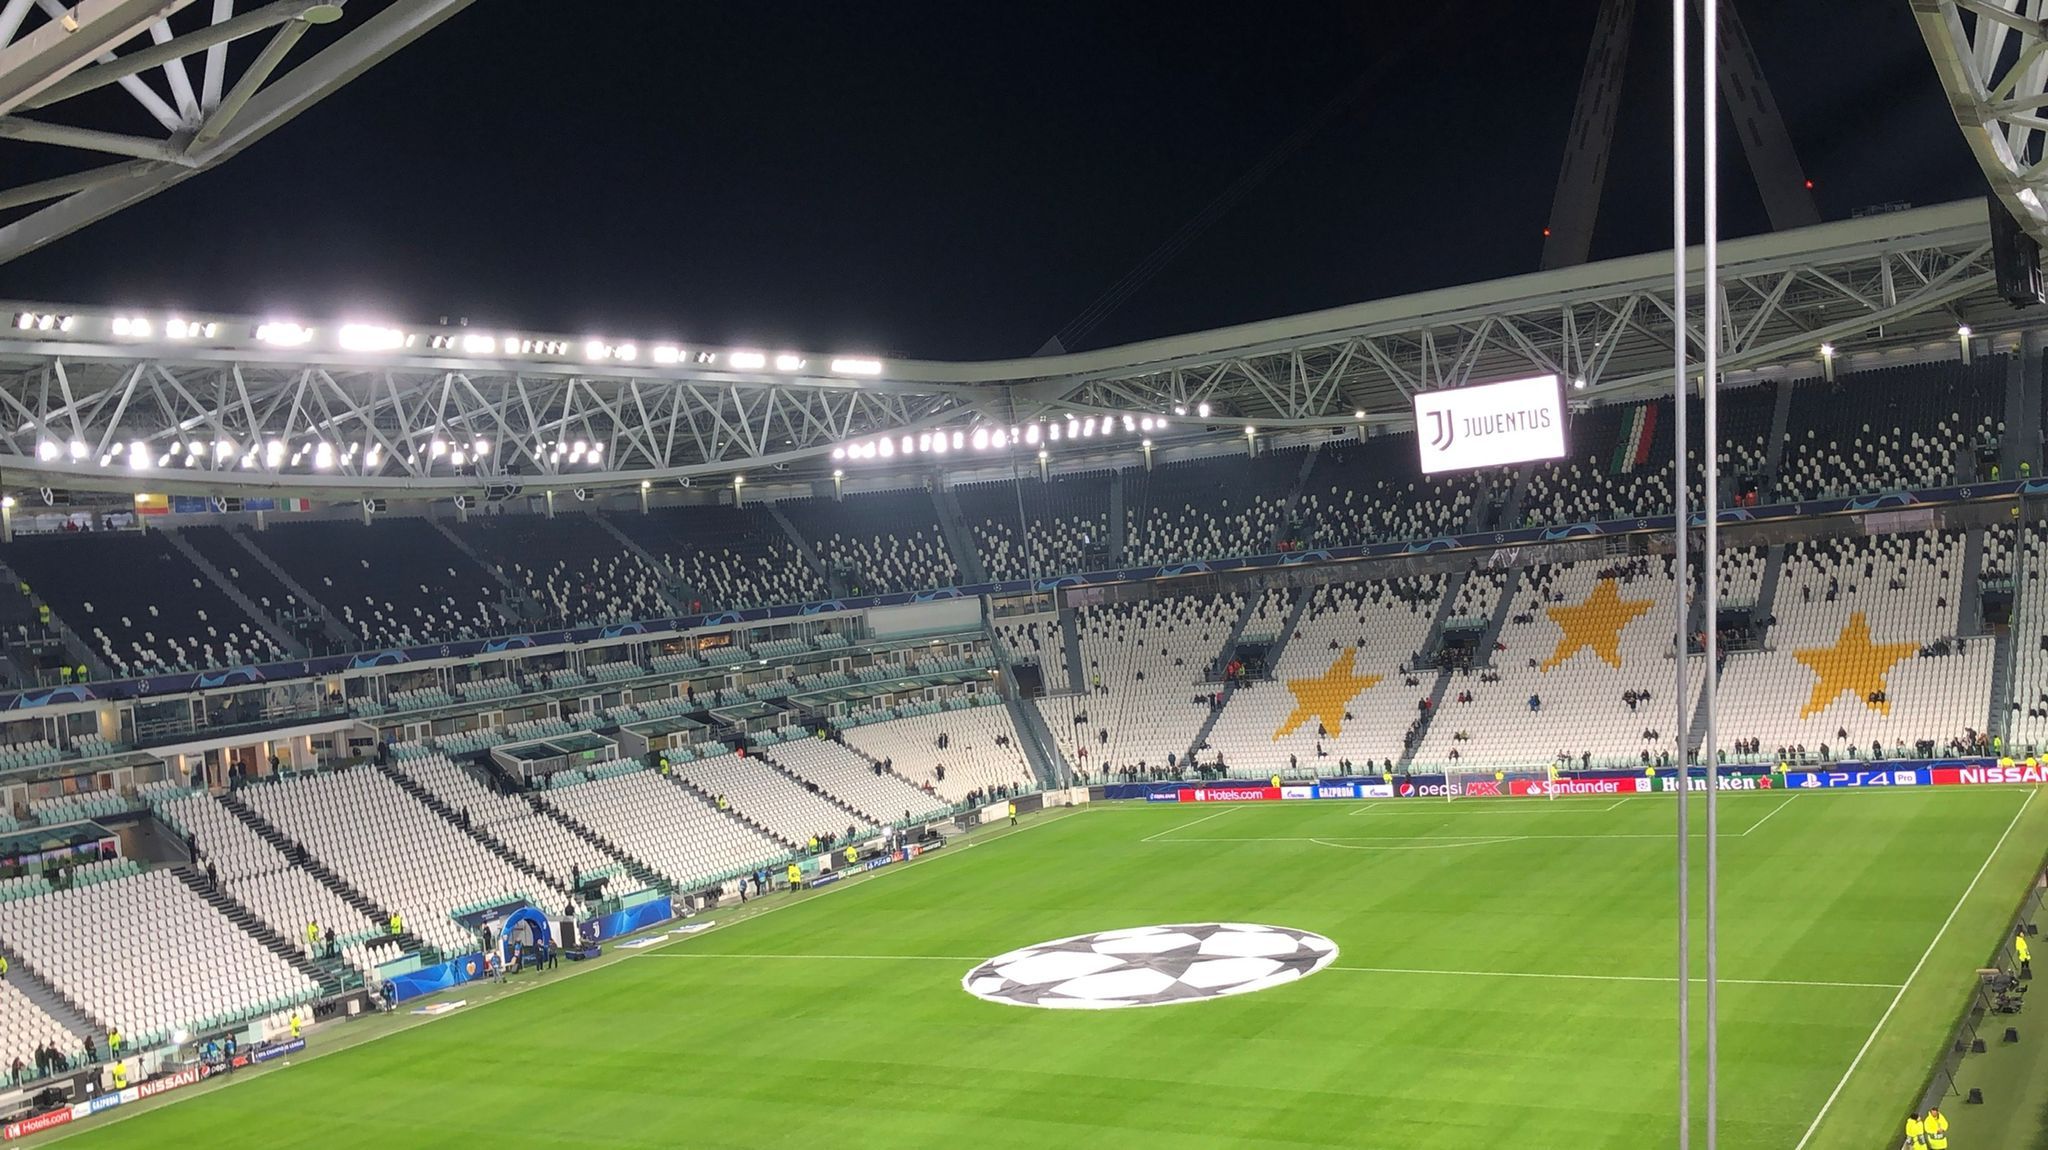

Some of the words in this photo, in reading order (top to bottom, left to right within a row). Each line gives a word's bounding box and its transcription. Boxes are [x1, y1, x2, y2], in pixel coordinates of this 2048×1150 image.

[1463, 407, 1551, 438] JUVENTUS
[1542, 780, 1620, 794] Santander
[1661, 776, 1756, 792] Hinken
[1828, 772, 1890, 787] PS4
[1897, 774, 1913, 782] Pro
[1207, 789, 1263, 801] Hotels.com
[1318, 787, 1355, 798] GAZPROM
[1418, 783, 1462, 797] pepsi
[1465, 781, 1502, 796] MAX
[140, 1070, 194, 1097] NISSAN
[92, 1095, 119, 1111] GAZPROM
[22, 1111, 70, 1133] Hotels.com
